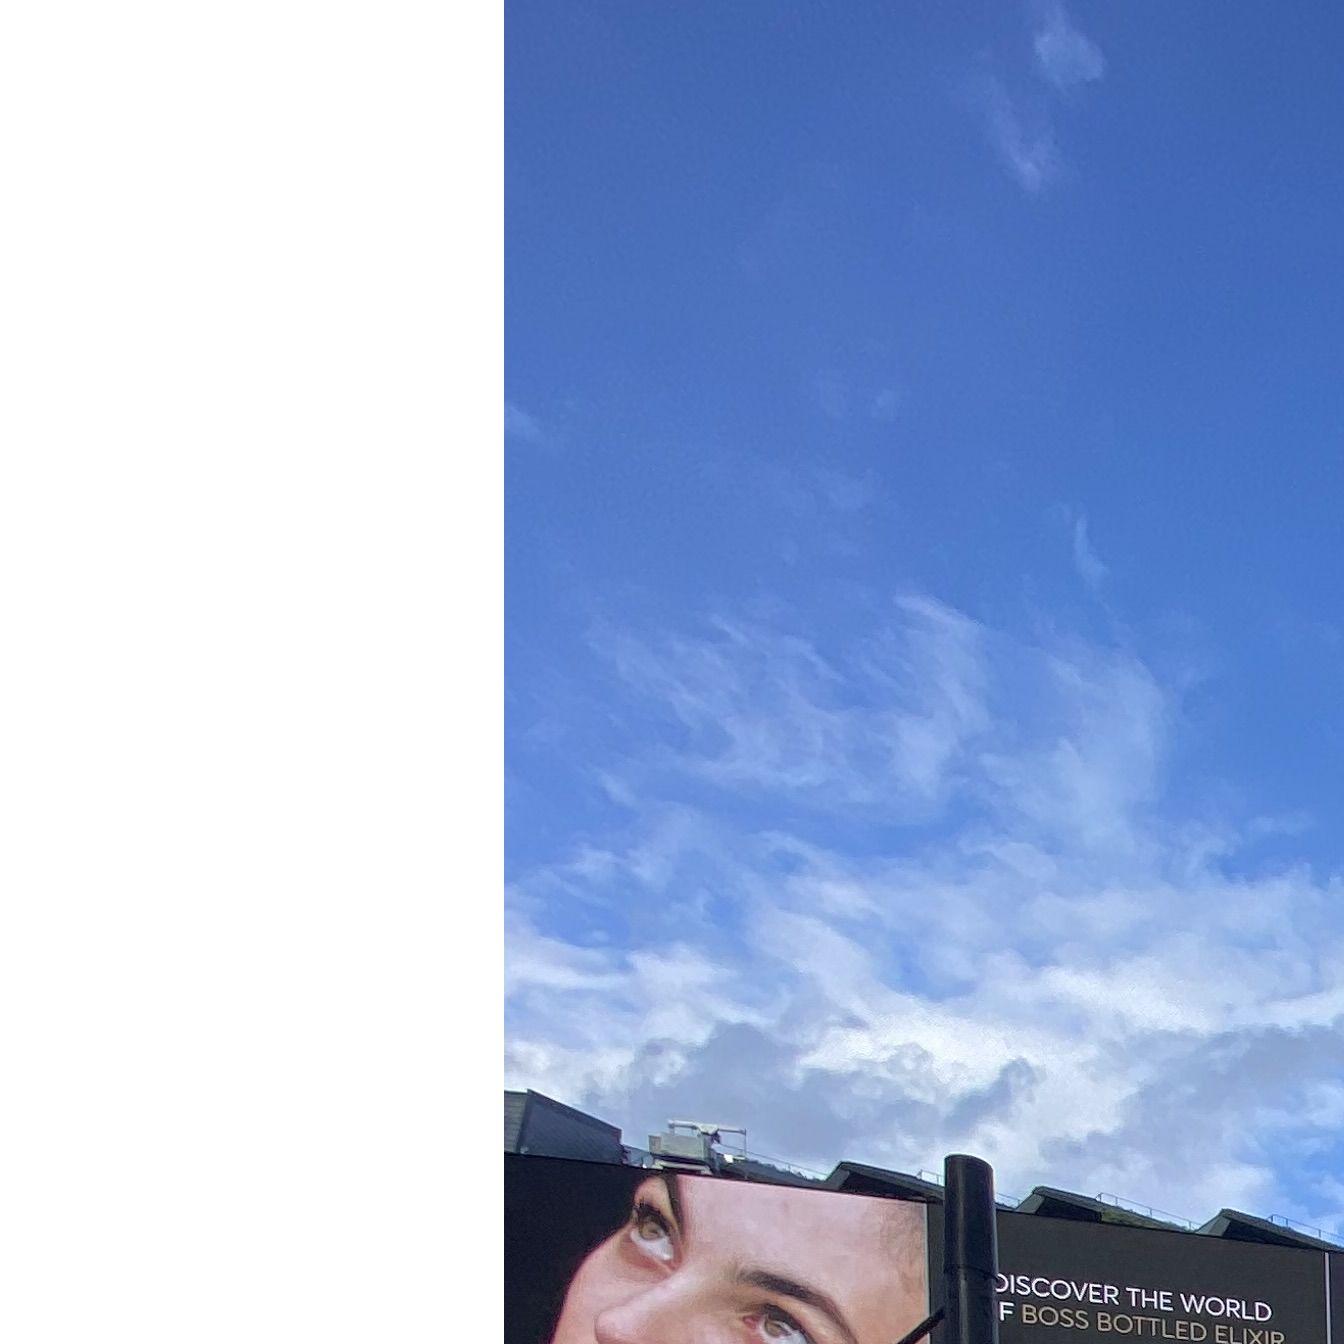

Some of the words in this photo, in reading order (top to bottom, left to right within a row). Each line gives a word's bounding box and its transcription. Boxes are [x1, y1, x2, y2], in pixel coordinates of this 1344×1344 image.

[995, 1273, 1120, 1306] DISCOVER
[1125, 1287, 1174, 1312] THE
[1180, 1294, 1272, 1322] WORLD
[999, 1302, 1015, 1321] F
[1022, 1304, 1089, 1330] BOSS
[1097, 1312, 1207, 1342] BOTTLED
